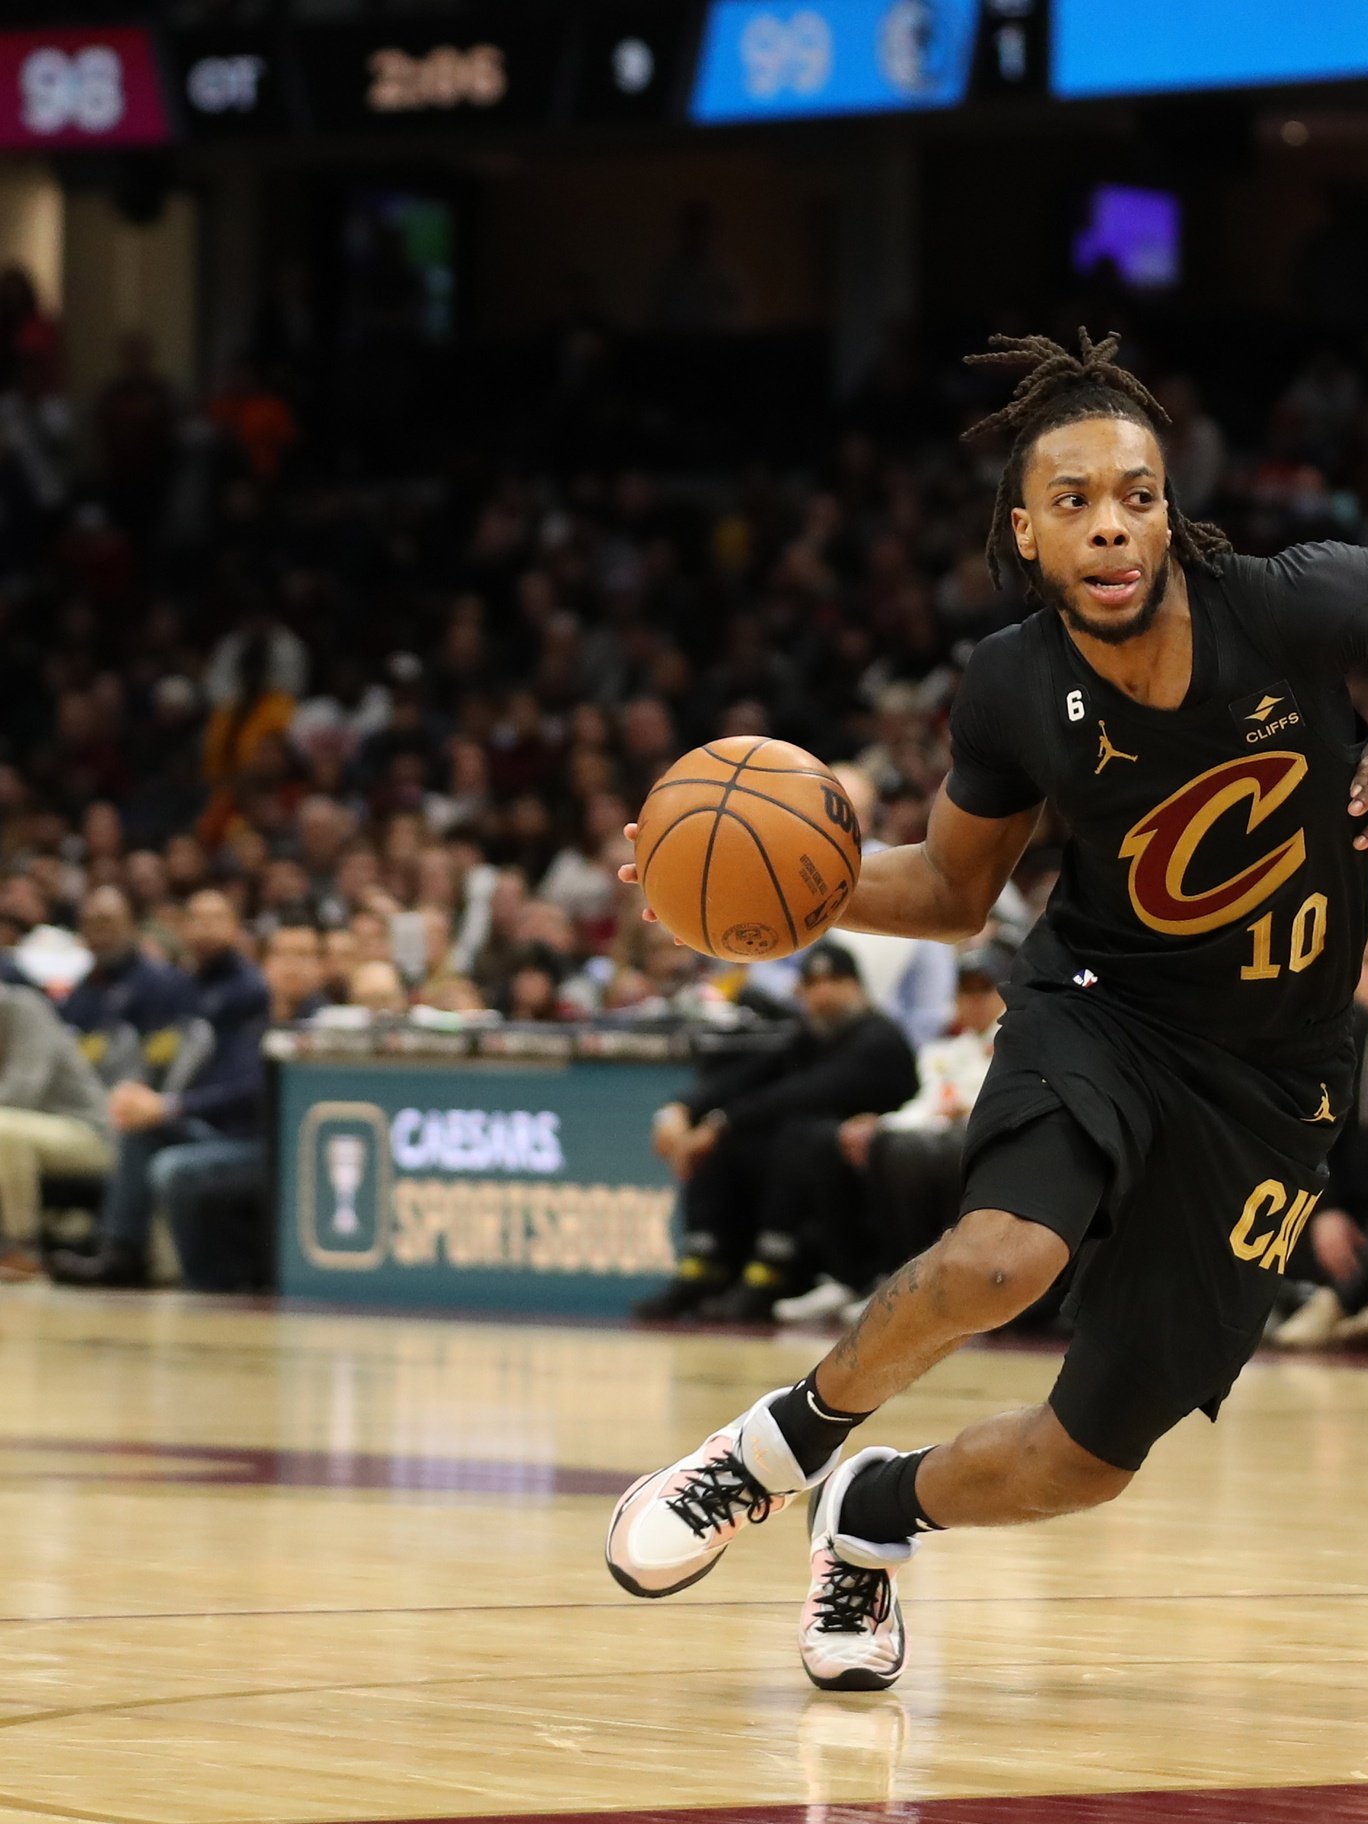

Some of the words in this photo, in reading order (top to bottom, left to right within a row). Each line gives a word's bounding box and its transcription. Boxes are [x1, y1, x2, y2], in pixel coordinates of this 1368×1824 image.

[1066, 690, 1085, 721] 6
[1246, 712, 1300, 743] CLIFFS
[1241, 892, 1328, 980] 10
